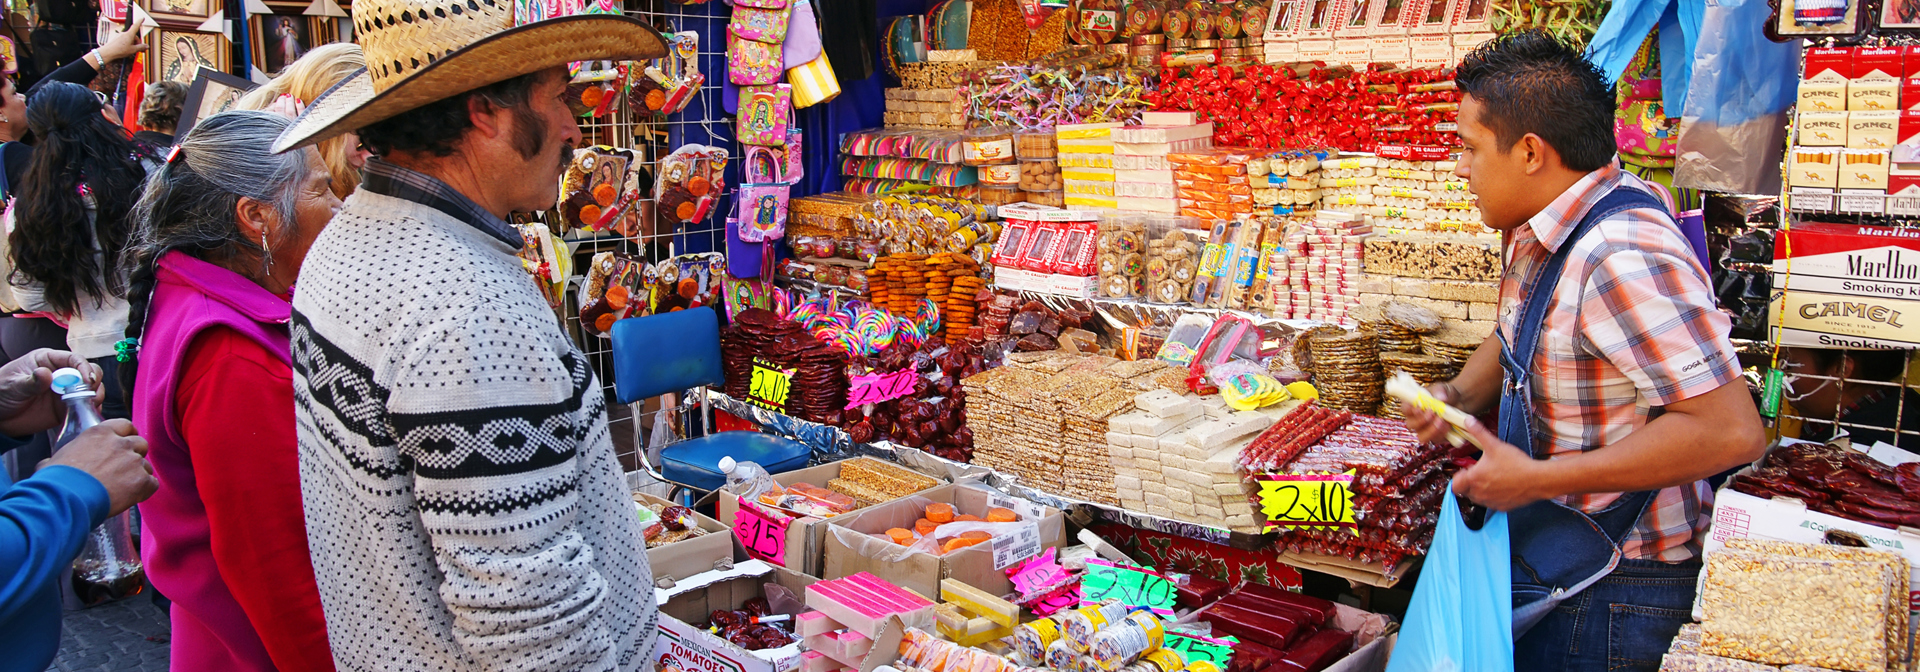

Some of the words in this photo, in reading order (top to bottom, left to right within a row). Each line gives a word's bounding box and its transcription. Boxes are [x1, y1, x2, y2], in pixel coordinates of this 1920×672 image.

[1853, 90, 1892, 98] CAMEL
[1804, 121, 1841, 130] CAMEL
[1853, 122, 1893, 130] CAMEL
[1843, 282, 1904, 296] Smoking
[1800, 302, 1904, 328] CAMEL
[738, 513, 779, 558] $15
[680, 637, 711, 658] MEXICAN
[671, 642, 725, 672] TOMATOES
